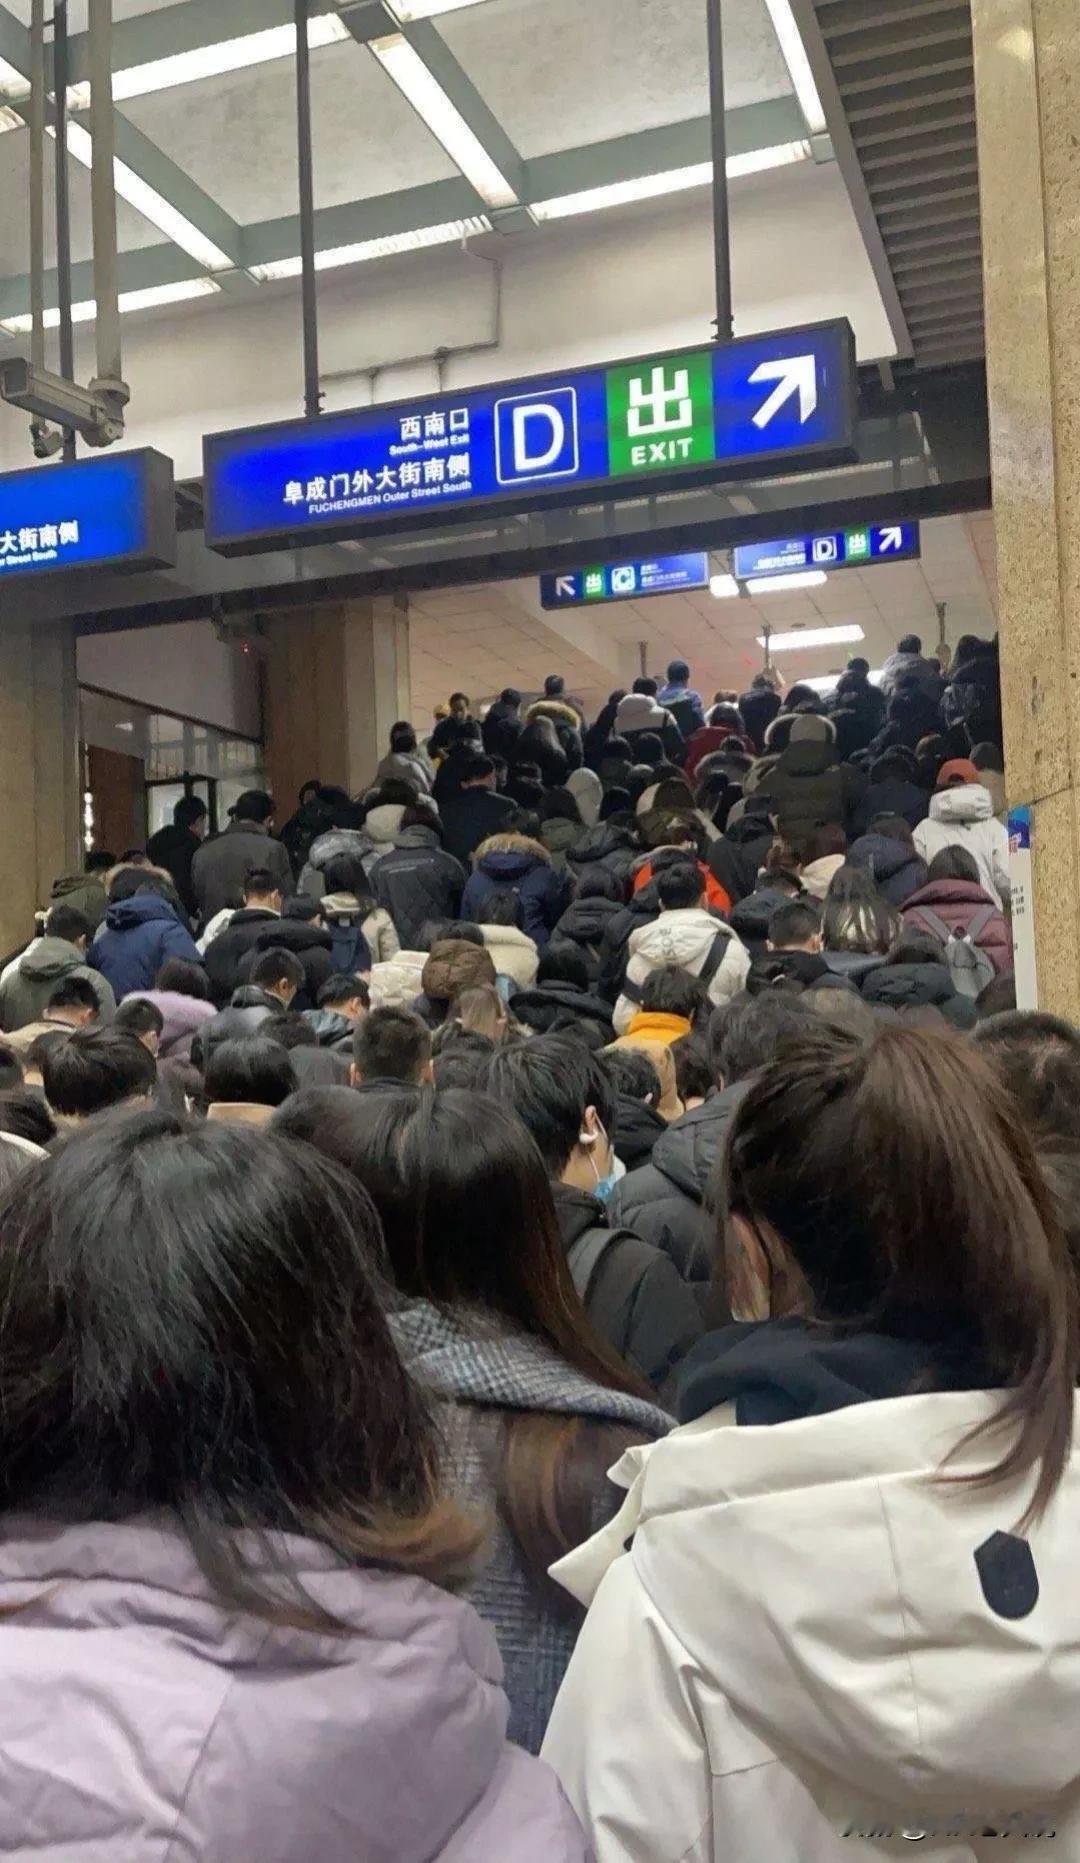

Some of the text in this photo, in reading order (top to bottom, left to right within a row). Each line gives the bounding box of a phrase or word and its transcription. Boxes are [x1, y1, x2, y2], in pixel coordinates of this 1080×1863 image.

[628, 366, 693, 437] 出
[400, 408, 469, 441] 西南口
[450, 433, 470, 445] Exit
[513, 404, 565, 472] D
[631, 437, 694, 466] EXIT
[284, 453, 469, 504] 阜成门外大街南侧
[308, 480, 472, 514] FUCHENGMEN Outer Street South
[0, 520, 78, 553] 大街南侧
[817, 540, 834, 561] D
